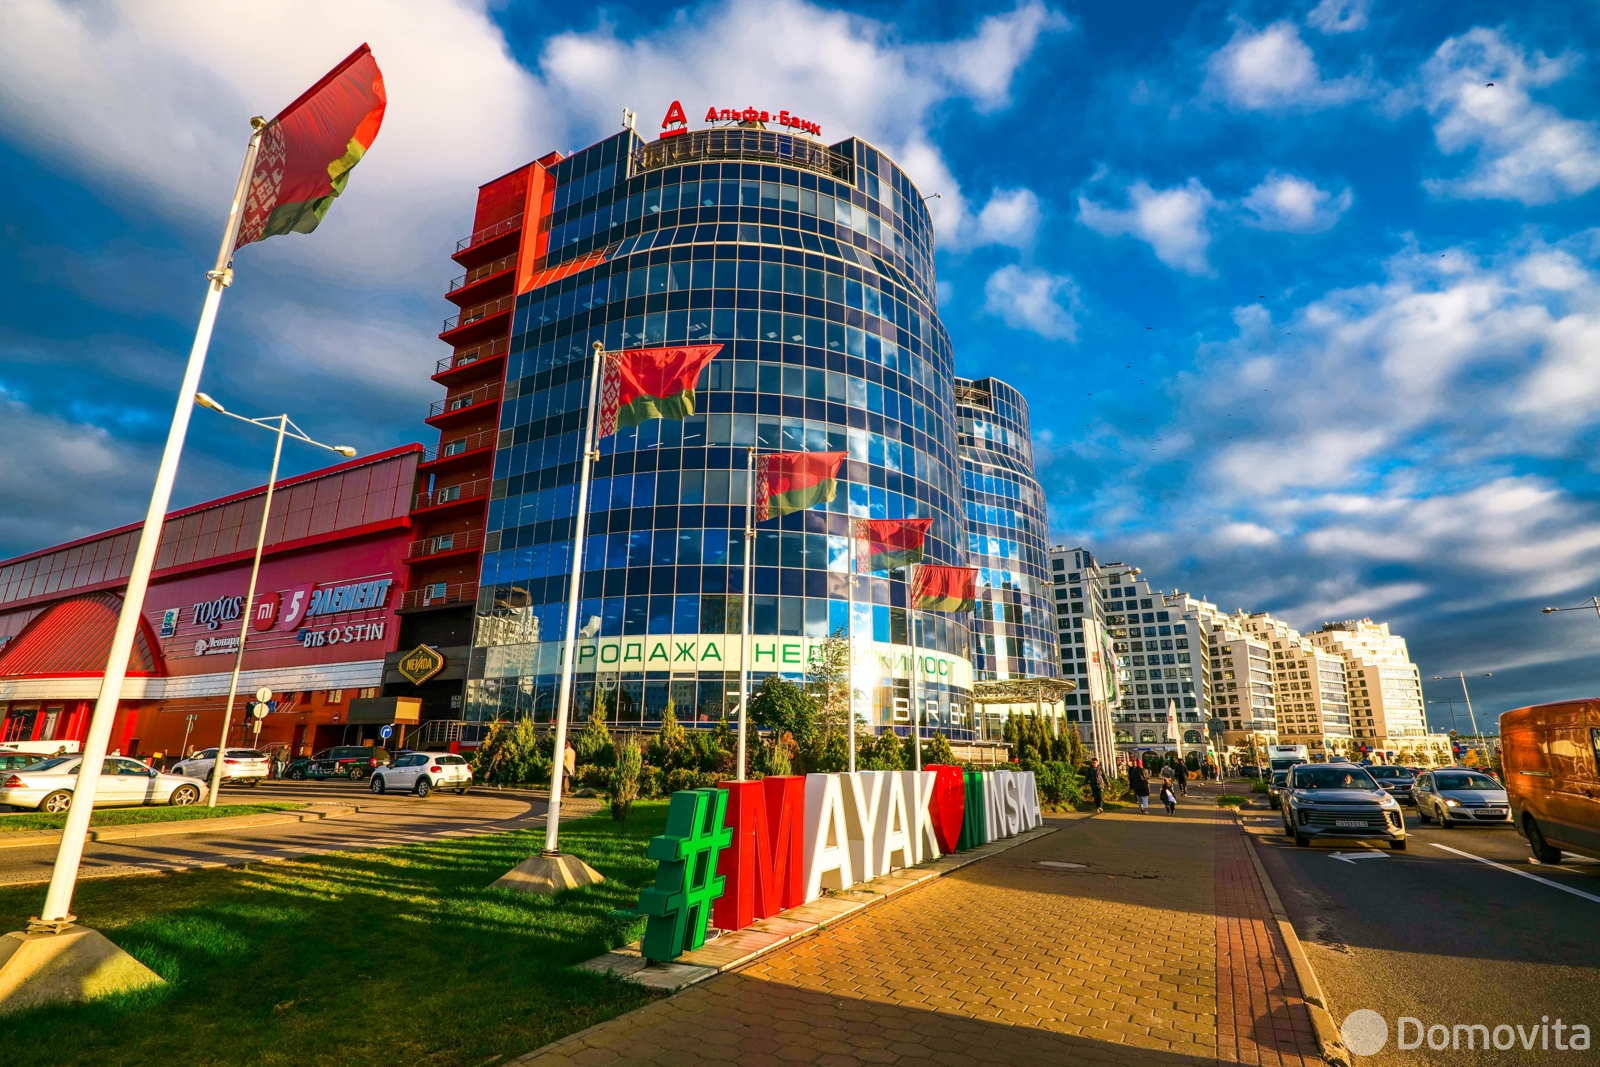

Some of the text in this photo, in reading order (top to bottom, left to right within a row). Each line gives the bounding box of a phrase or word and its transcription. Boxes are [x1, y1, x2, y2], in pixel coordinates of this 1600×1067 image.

[285, 578, 393, 622] 5 ЭЛЕМЕНТ
[303, 630, 325, 648] ВТБ
[406, 655, 433, 673] NEVADA
[962, 769, 1043, 849] MINSKA
